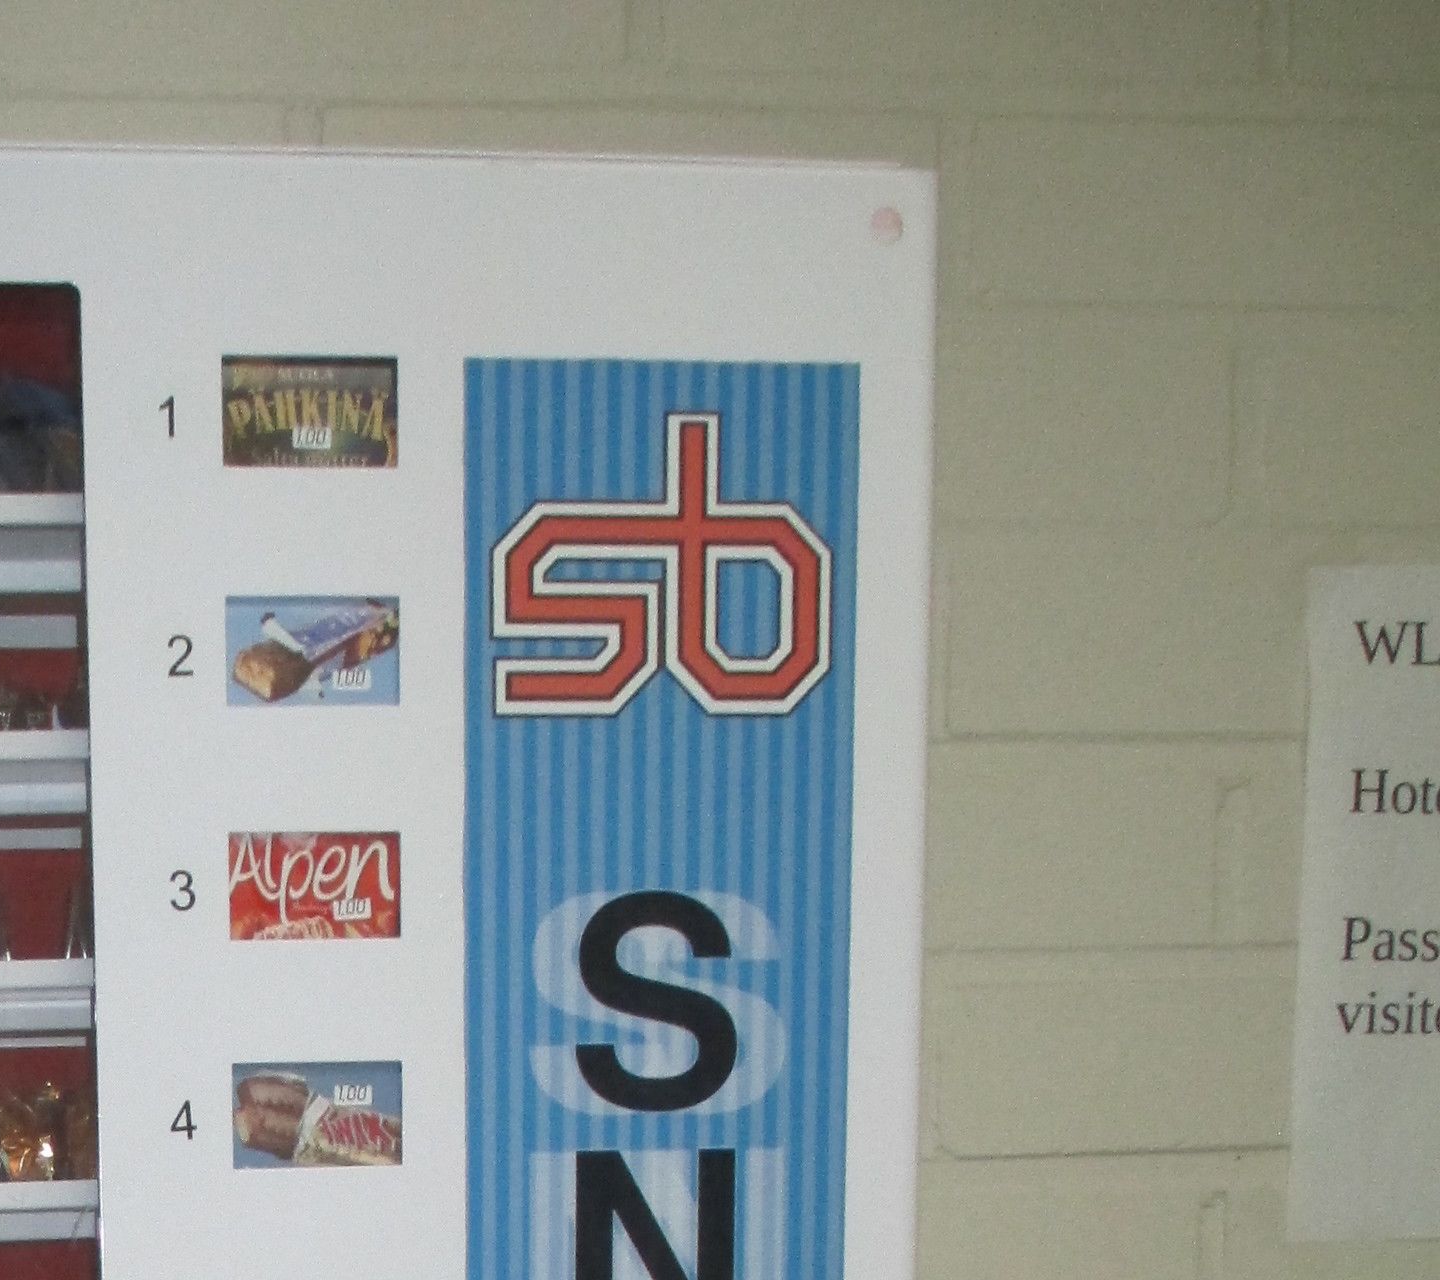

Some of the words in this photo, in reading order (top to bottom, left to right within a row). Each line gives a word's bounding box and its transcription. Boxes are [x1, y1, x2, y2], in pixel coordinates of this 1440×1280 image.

[159, 395, 174, 438] 1
[167, 634, 194, 677] 2
[1349, 768, 1440, 815] Hot
[170, 869, 197, 912] 3
[229, 832, 395, 927] Alpen
[170, 1099, 198, 1140] 4
